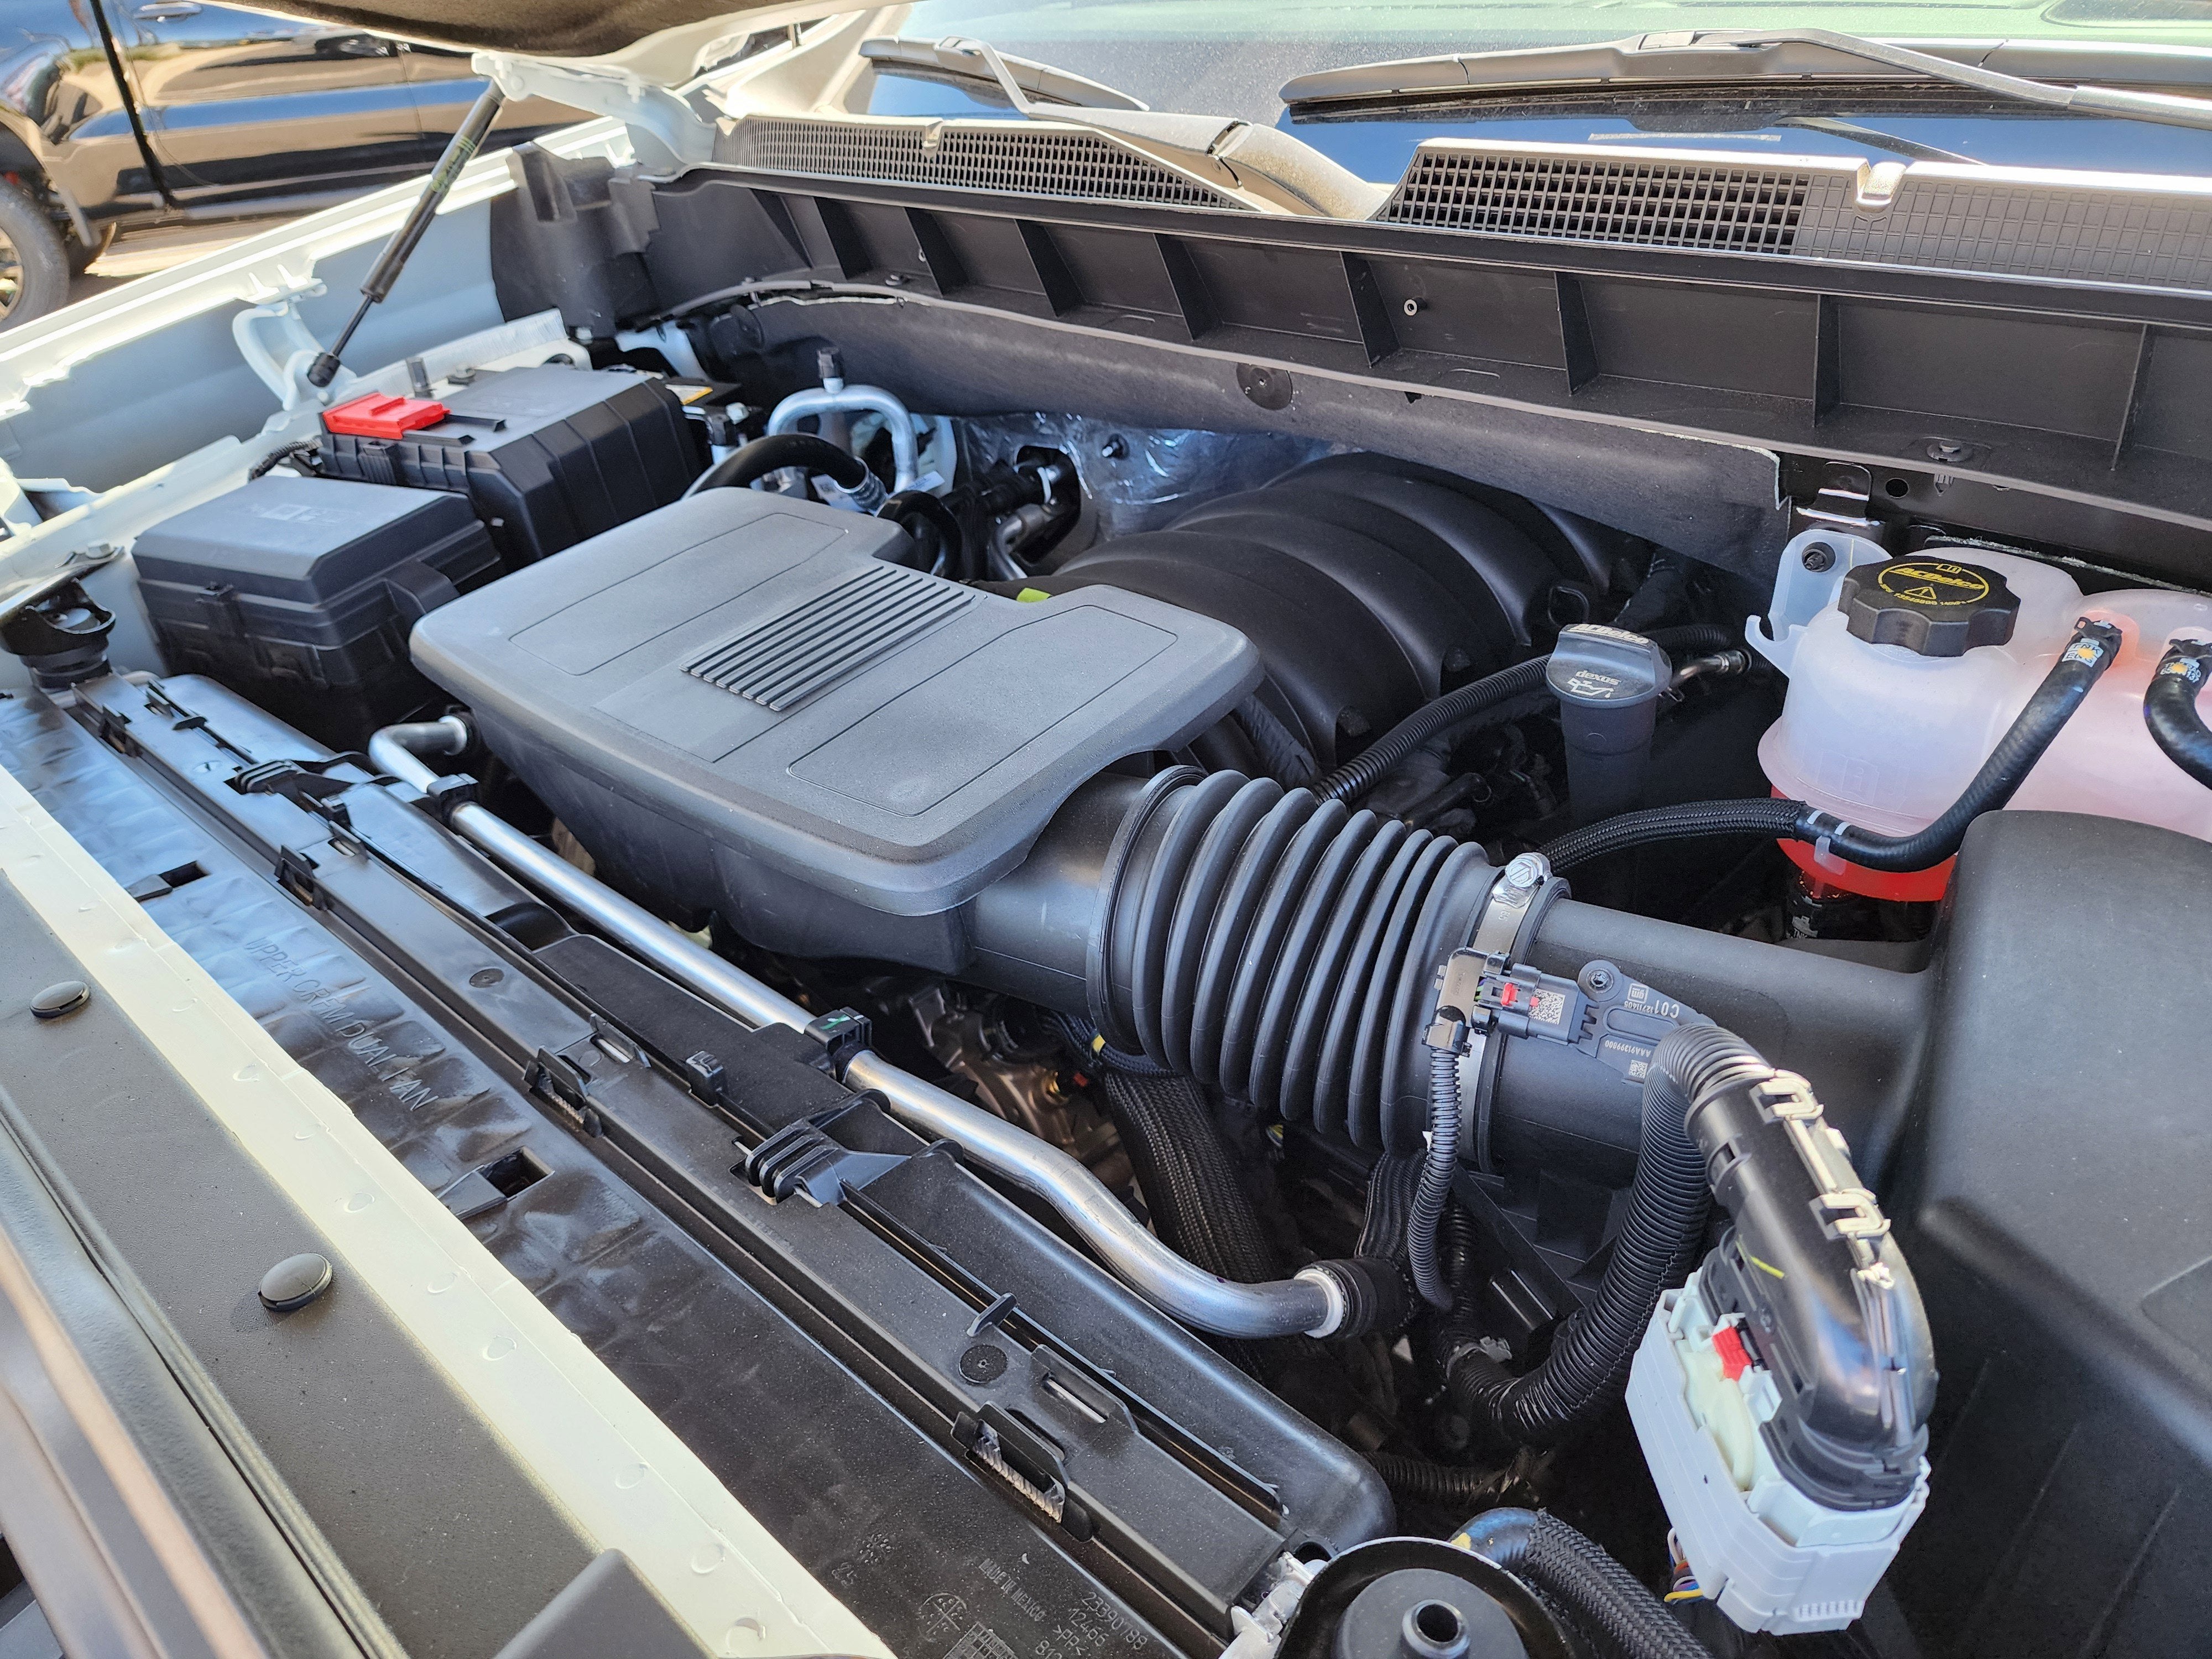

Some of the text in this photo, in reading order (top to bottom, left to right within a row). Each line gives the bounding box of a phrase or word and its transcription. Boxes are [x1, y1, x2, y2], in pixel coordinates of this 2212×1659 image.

[1891, 567, 1985, 589] ACDelco
[1569, 623, 1649, 644] ACDelco
[2074, 643, 2100, 655] TNK
[1576, 670, 1621, 685] dexos
[244, 937, 306, 982] UPPER
[334, 1021, 398, 1073] DUAL
[1653, 1000, 1680, 1019] C01
[978, 1558, 1048, 1621] MADE IN MEXICO
[1082, 1591, 1148, 1650] 23390788
